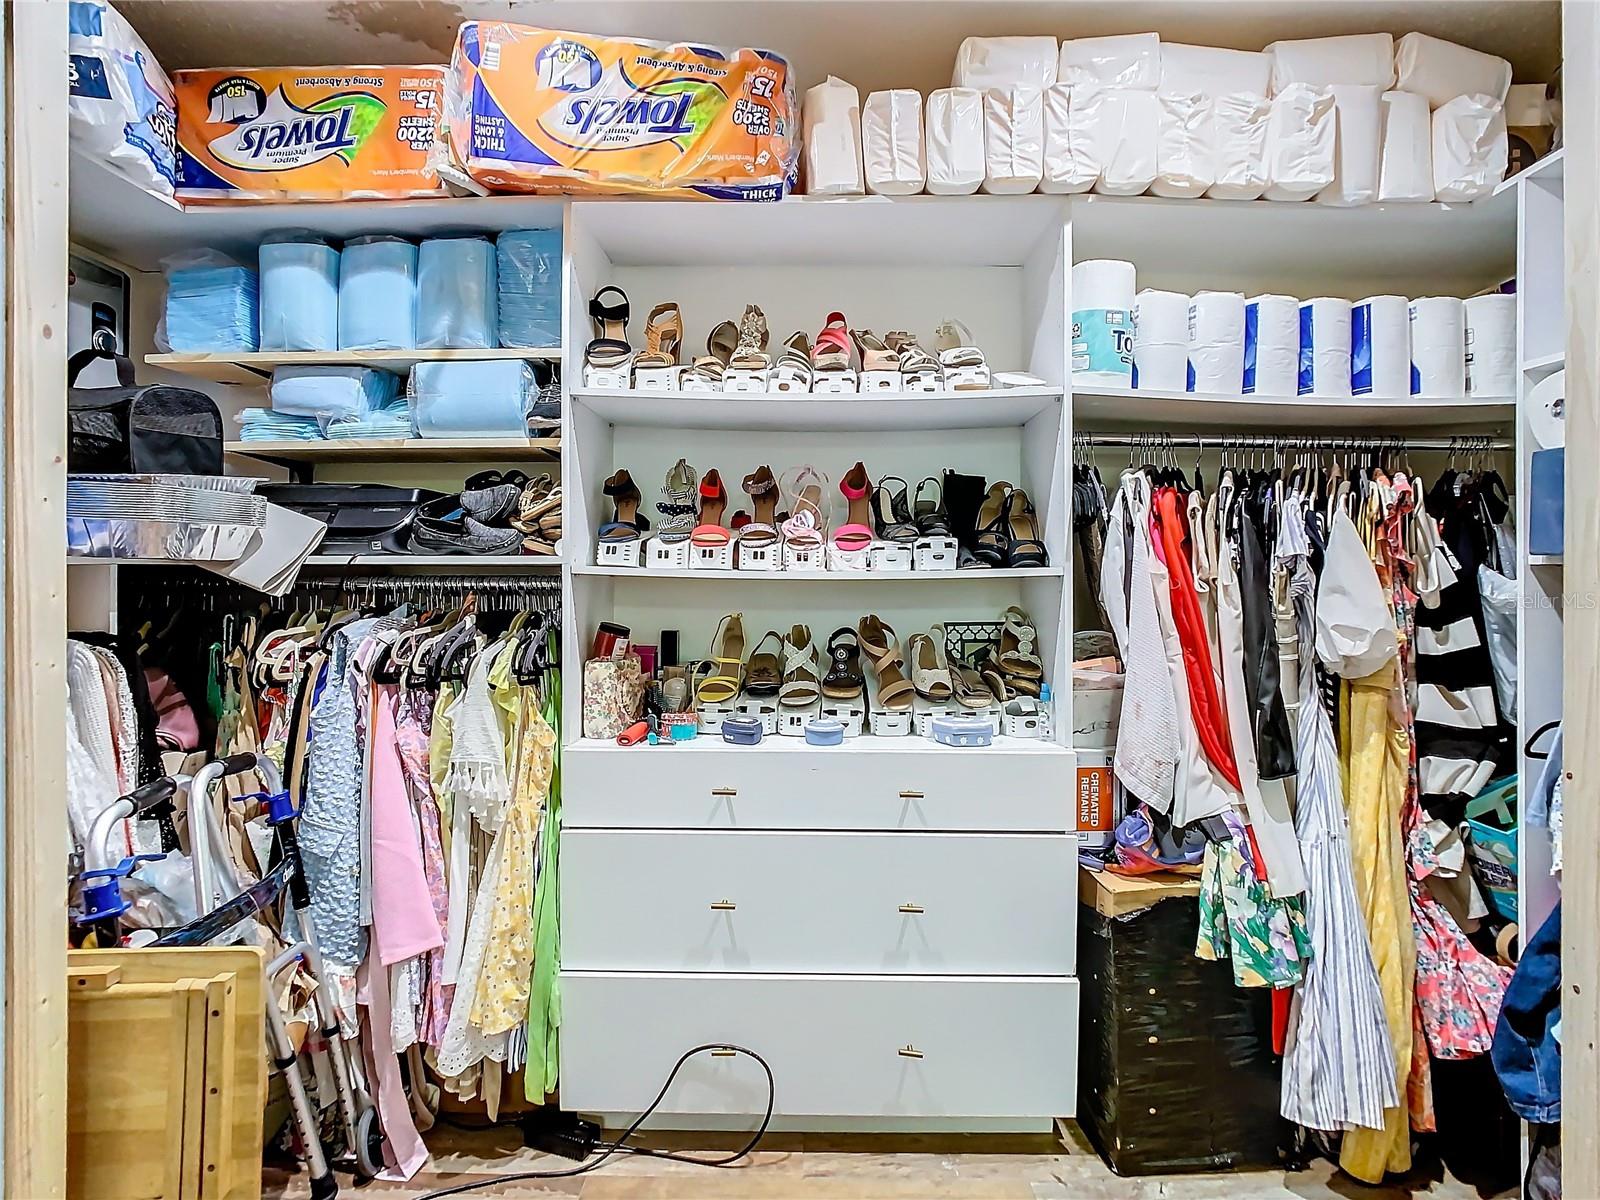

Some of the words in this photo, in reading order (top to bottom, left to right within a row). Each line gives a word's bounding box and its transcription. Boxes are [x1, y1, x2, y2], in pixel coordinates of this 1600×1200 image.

[636, 56, 686, 72] Absorbent
[687, 63, 696, 73] &
[294, 77, 342, 88] Absorbent
[344, 78, 351, 87] &
[353, 76, 384, 88] Strong
[750, 76, 775, 98] 15
[226, 85, 246, 97] 150
[415, 90, 437, 109] 15
[475, 114, 505, 127] LASTING
[566, 92, 695, 137] Towels
[399, 116, 435, 128] SHEETS
[238, 106, 355, 158] Towels
[396, 126, 435, 142] 2200
[475, 124, 496, 137] LONG
[498, 127, 505, 138] &
[747, 123, 770, 135] OVER
[474, 135, 506, 152] THICK
[600, 135, 631, 143] Super
[410, 141, 434, 150] OVER
[266, 149, 307, 159] Premium
[272, 156, 299, 164] Super
[741, 188, 777, 200] THICK
[1081, 777, 1090, 823] REMAINS
[1090, 772, 1100, 827] CREMATED
